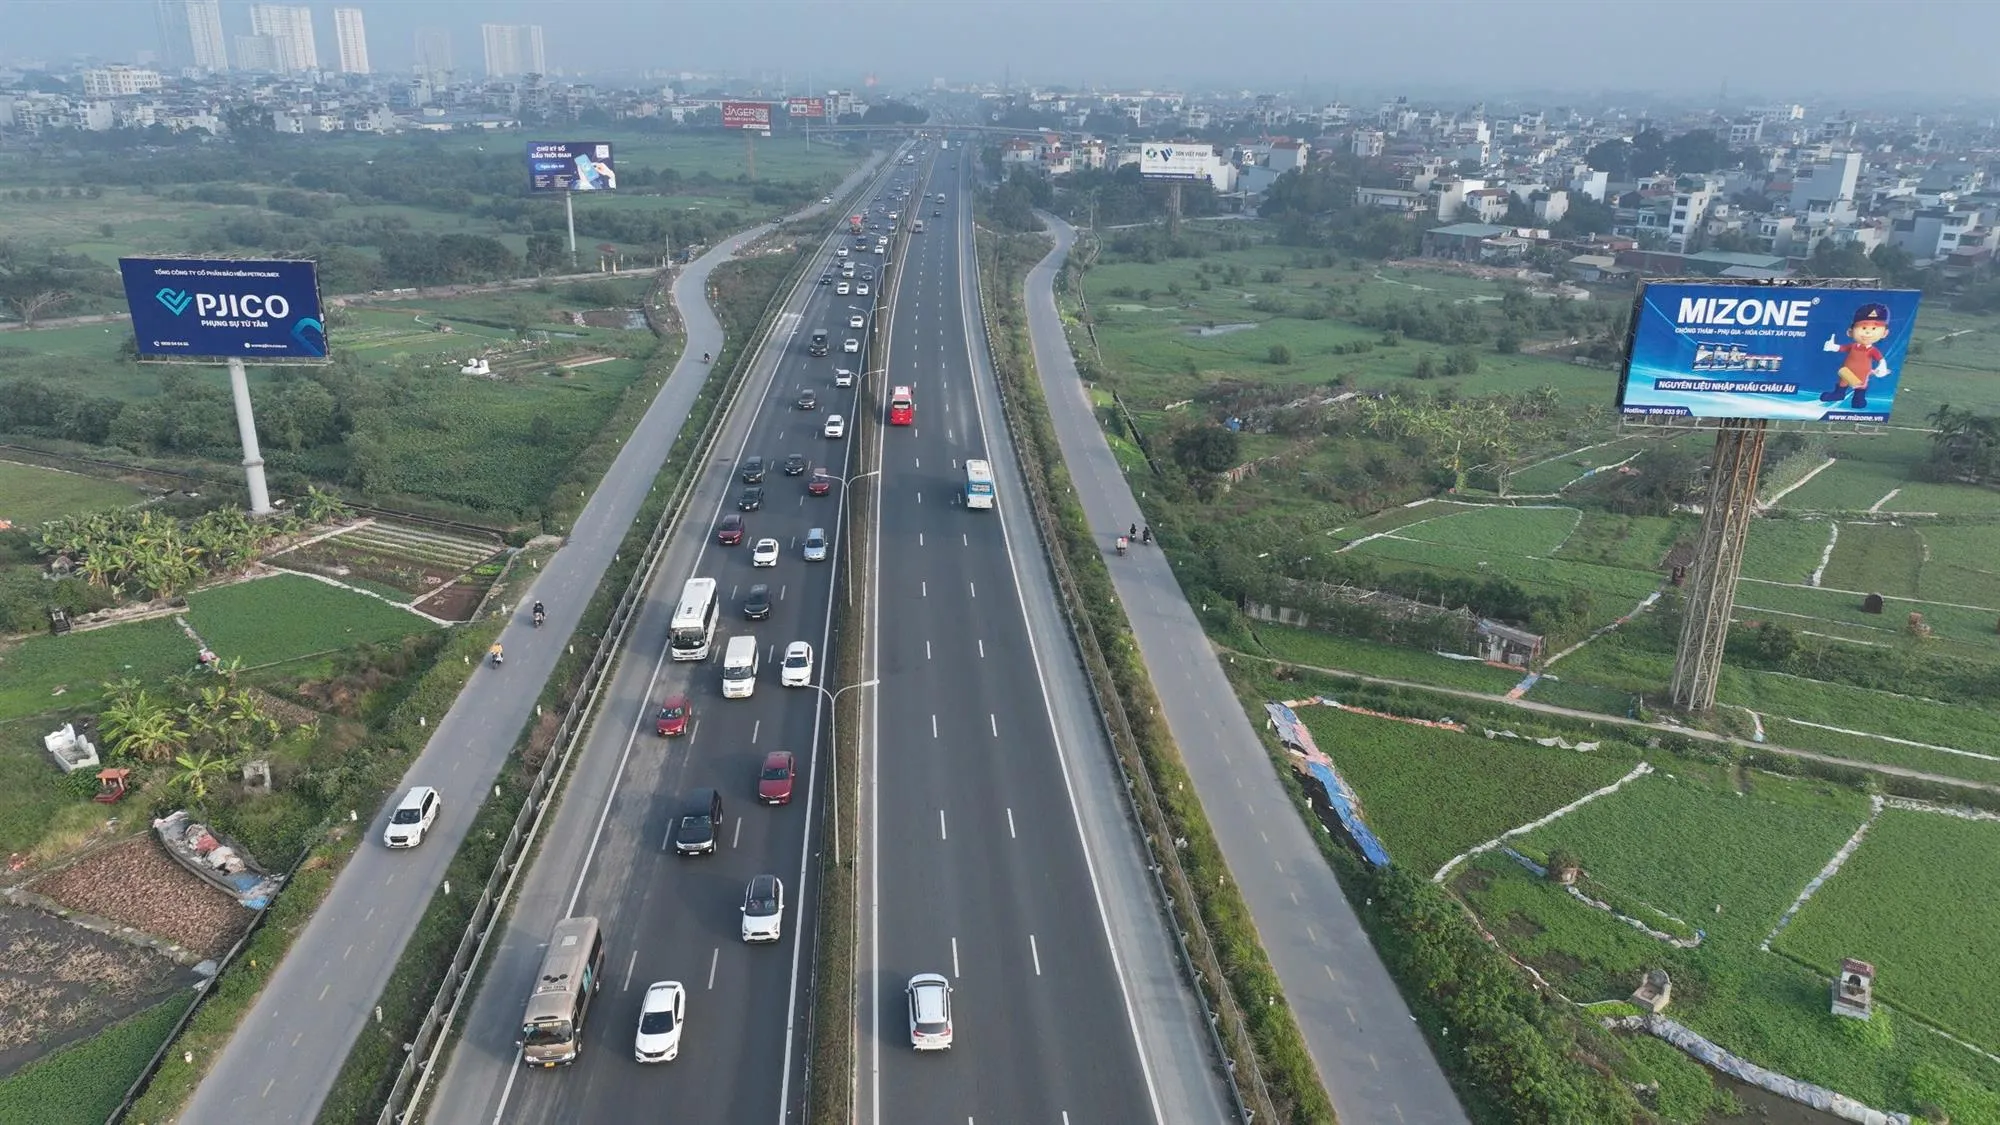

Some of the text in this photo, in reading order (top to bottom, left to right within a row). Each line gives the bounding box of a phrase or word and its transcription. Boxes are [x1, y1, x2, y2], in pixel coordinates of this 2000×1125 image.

[196, 293, 290, 318] PJICO
[1677, 297, 1812, 326] MIZONE
[201, 320, 228, 328] PHỤNG
[228, 320, 240, 328] SỰ
[252, 320, 268, 328] TÂM
[1658, 380, 1796, 393] NGUYÊN LIỆU NHẬP KHẨU CHÂU ÂU
[1828, 414, 1884, 422] www.mizone.vn
